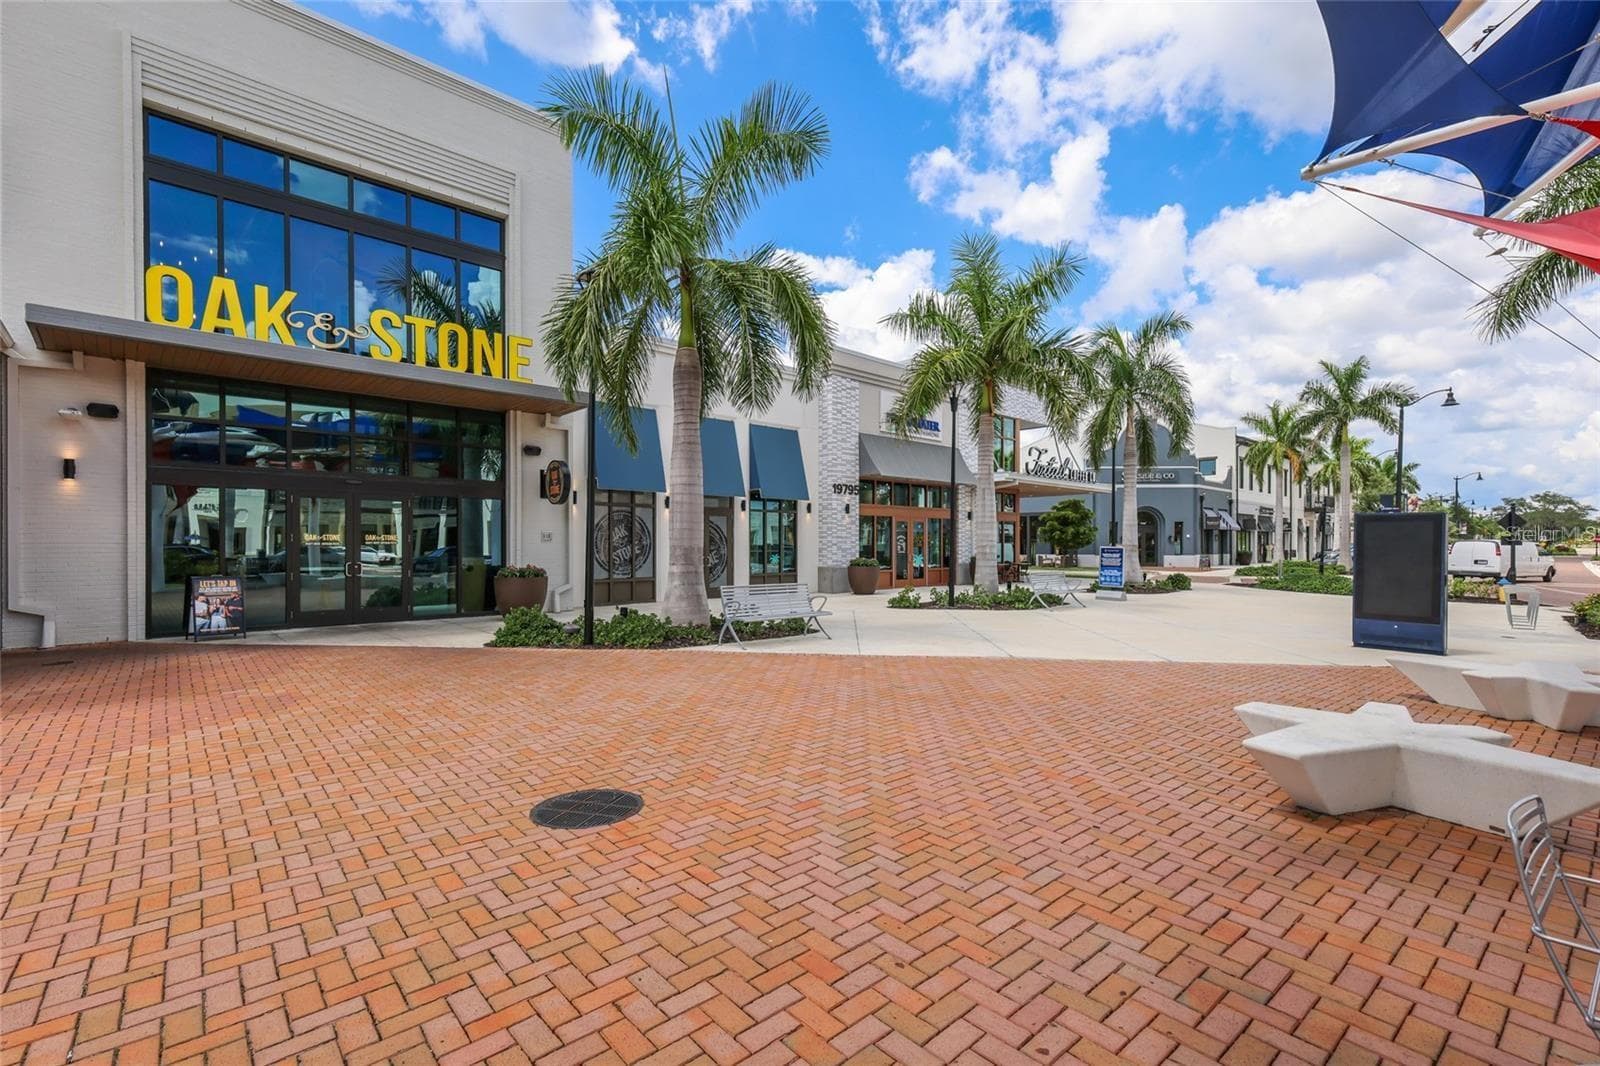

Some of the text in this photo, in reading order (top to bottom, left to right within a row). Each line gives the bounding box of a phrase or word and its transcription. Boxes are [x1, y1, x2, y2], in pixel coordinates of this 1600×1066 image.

[145, 264, 533, 383] OAK & STONE
[832, 483, 860, 496] 19795
